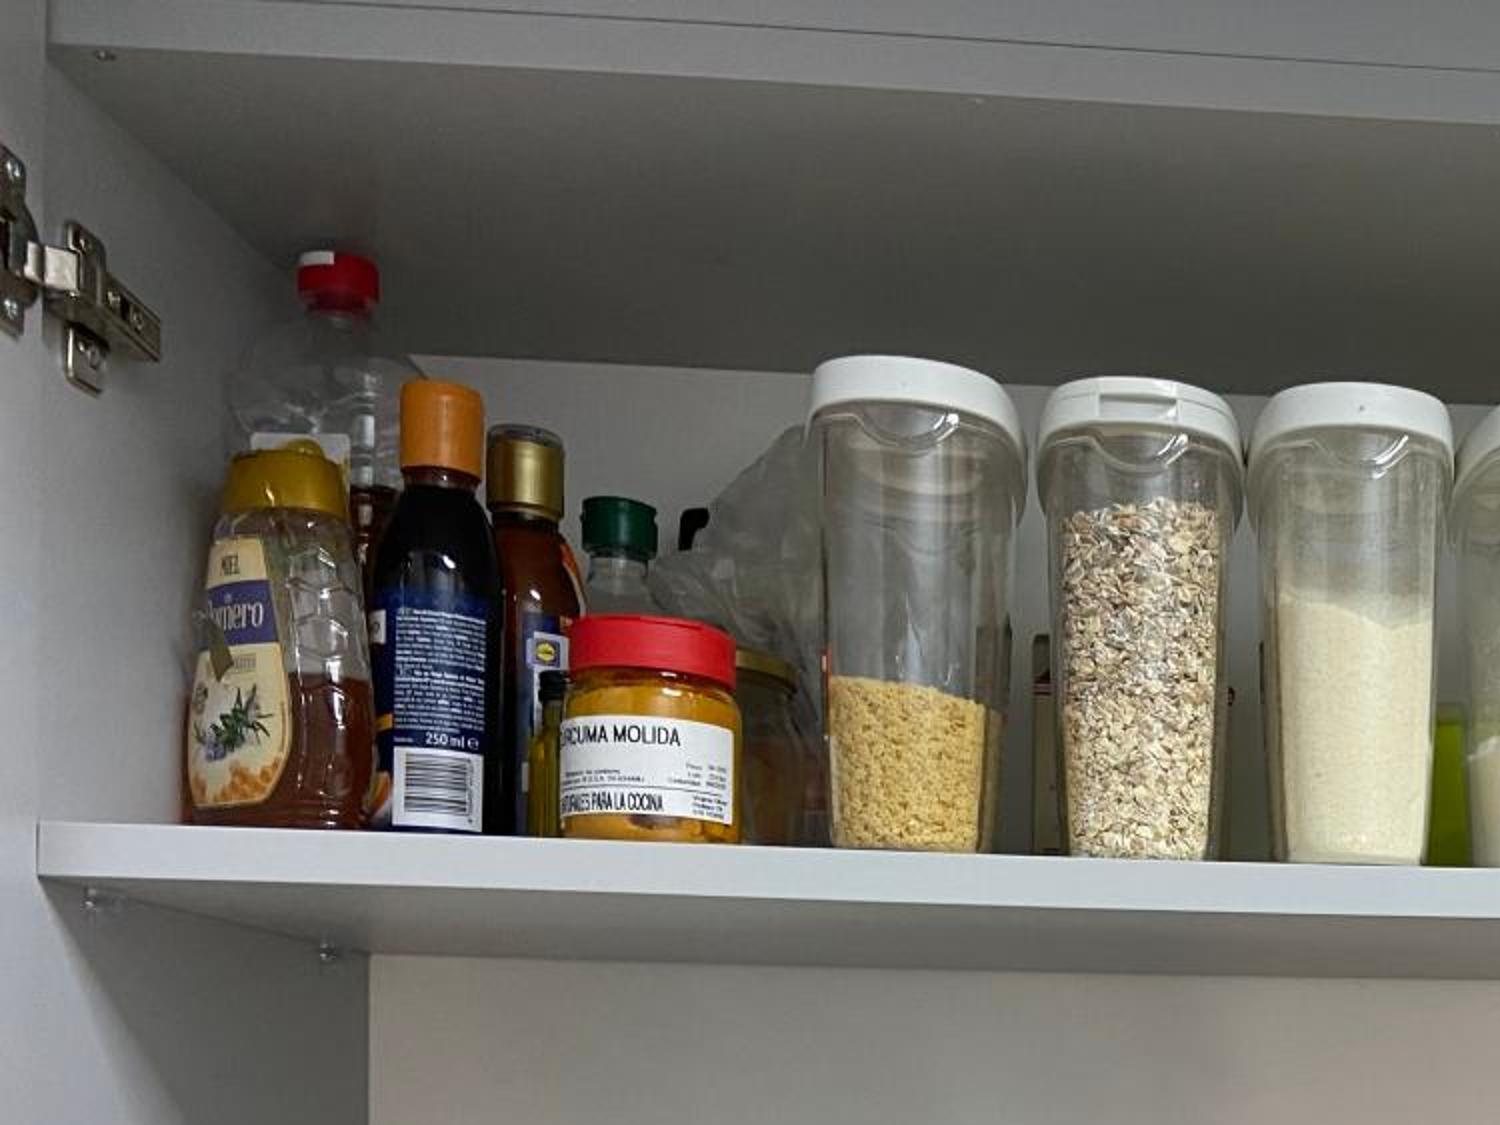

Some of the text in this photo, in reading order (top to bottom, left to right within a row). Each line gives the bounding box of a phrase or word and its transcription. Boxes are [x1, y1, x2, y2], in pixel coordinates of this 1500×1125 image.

[208, 600, 264, 630] omero
[425, 732, 448, 745] 250
[450, 735, 465, 749] ml
[561, 725, 681, 747] RCUMA MOLIDA
